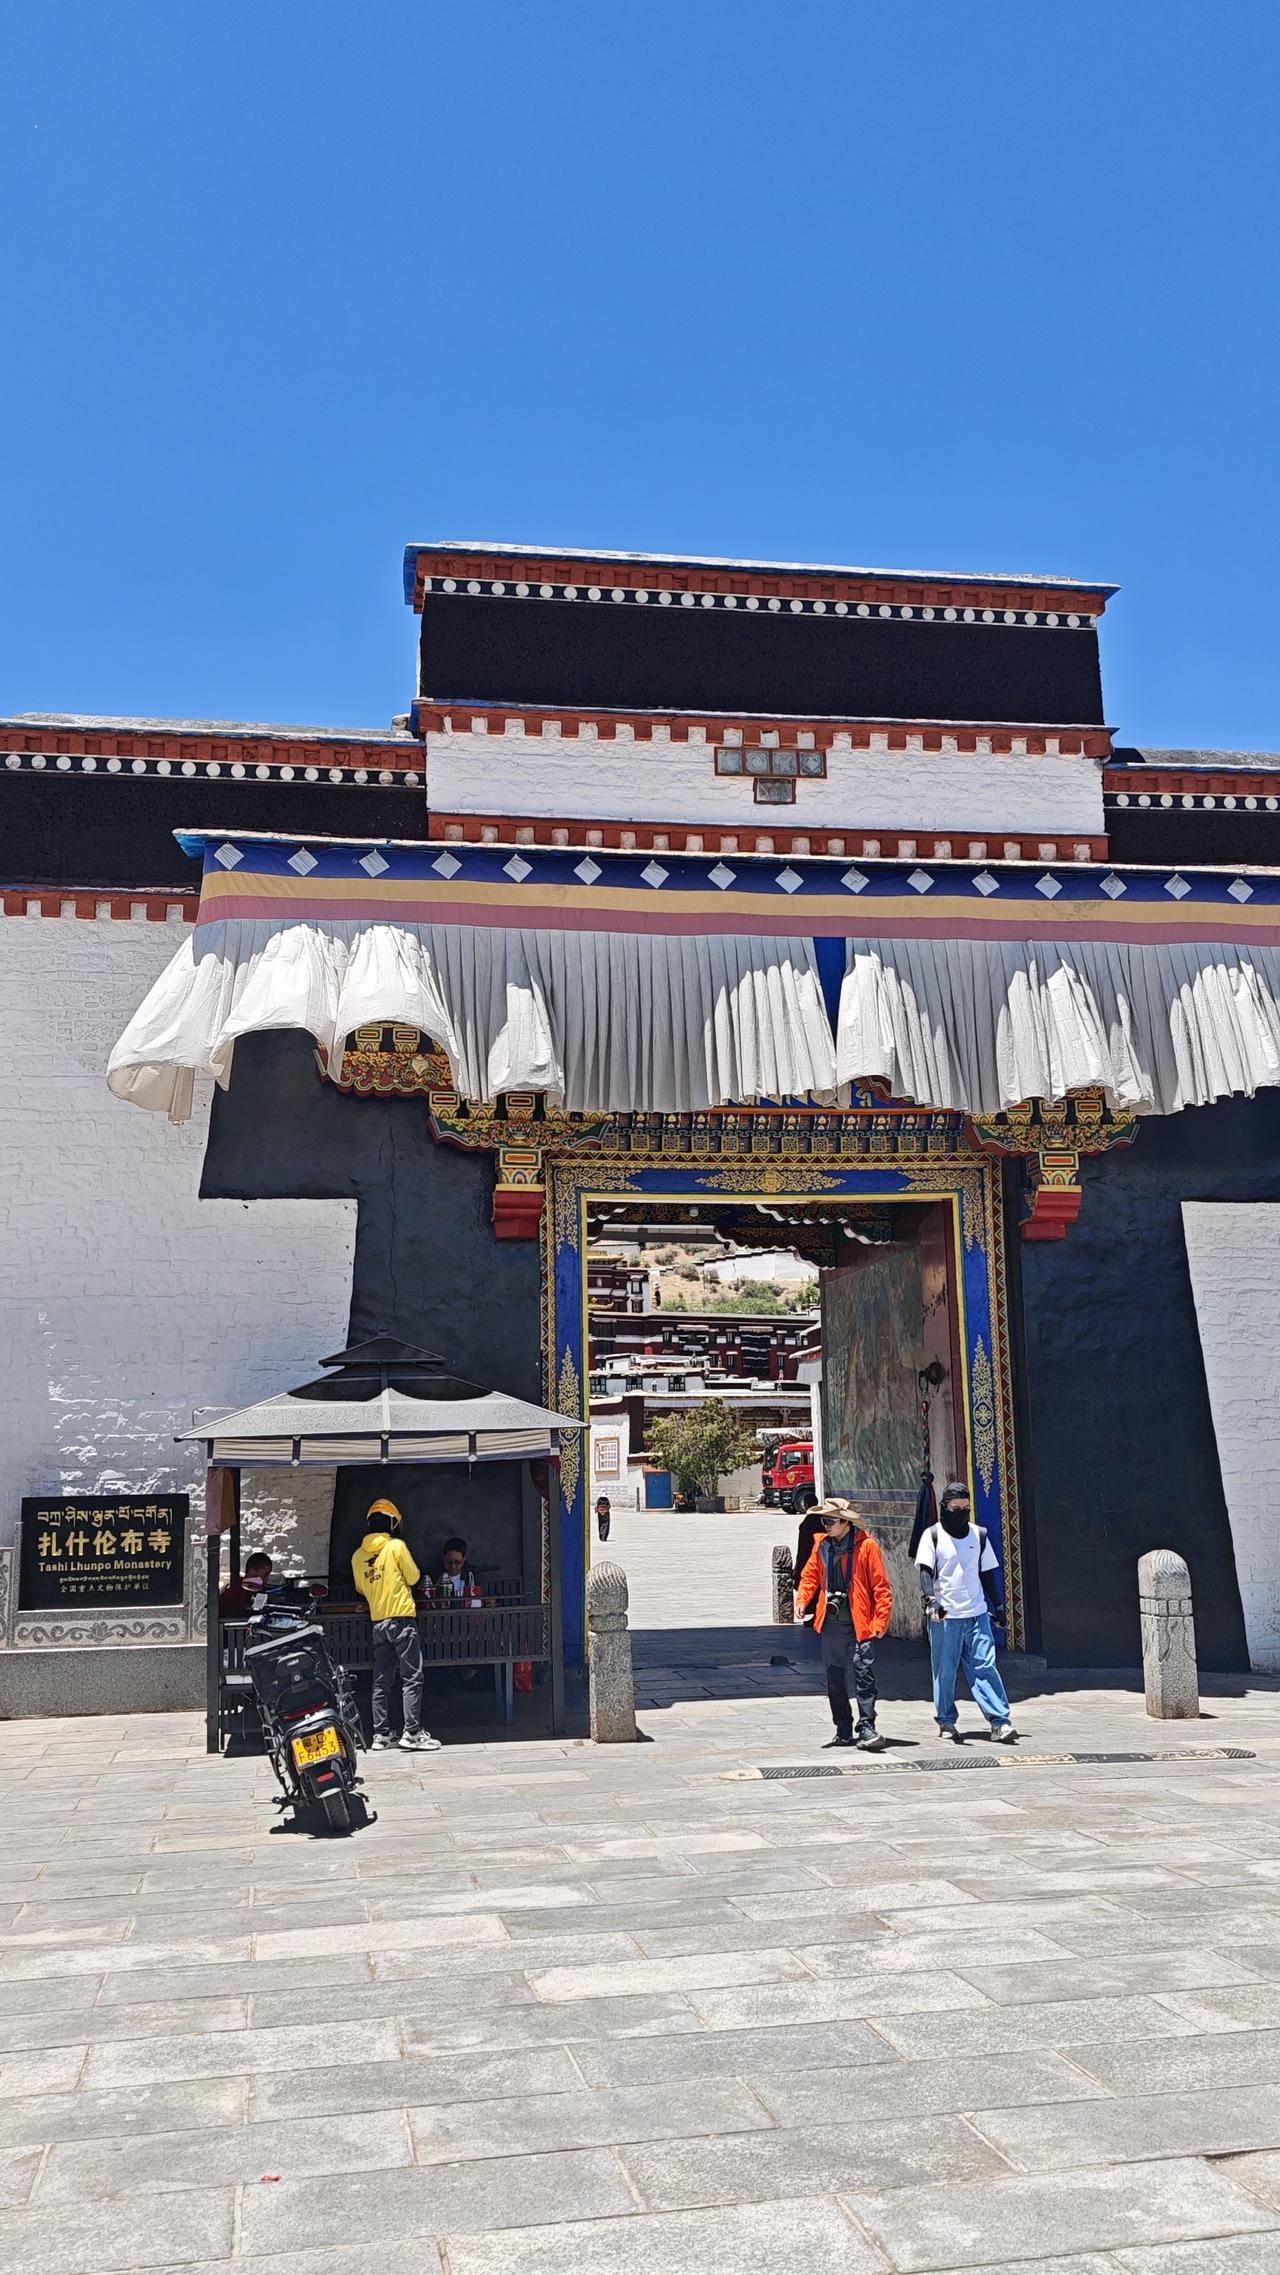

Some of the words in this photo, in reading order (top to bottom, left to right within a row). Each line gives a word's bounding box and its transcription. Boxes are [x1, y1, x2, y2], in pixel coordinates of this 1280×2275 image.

[37, 1528, 172, 1557] 扎什伦布寺
[38, 1562, 69, 1573] Tashi
[70, 1560, 112, 1573] Lhunpo
[113, 1559, 172, 1571] Monastery
[60, 1583, 150, 1593] 全国重点文物保护单位
[298, 1741, 337, 1764] F6453
